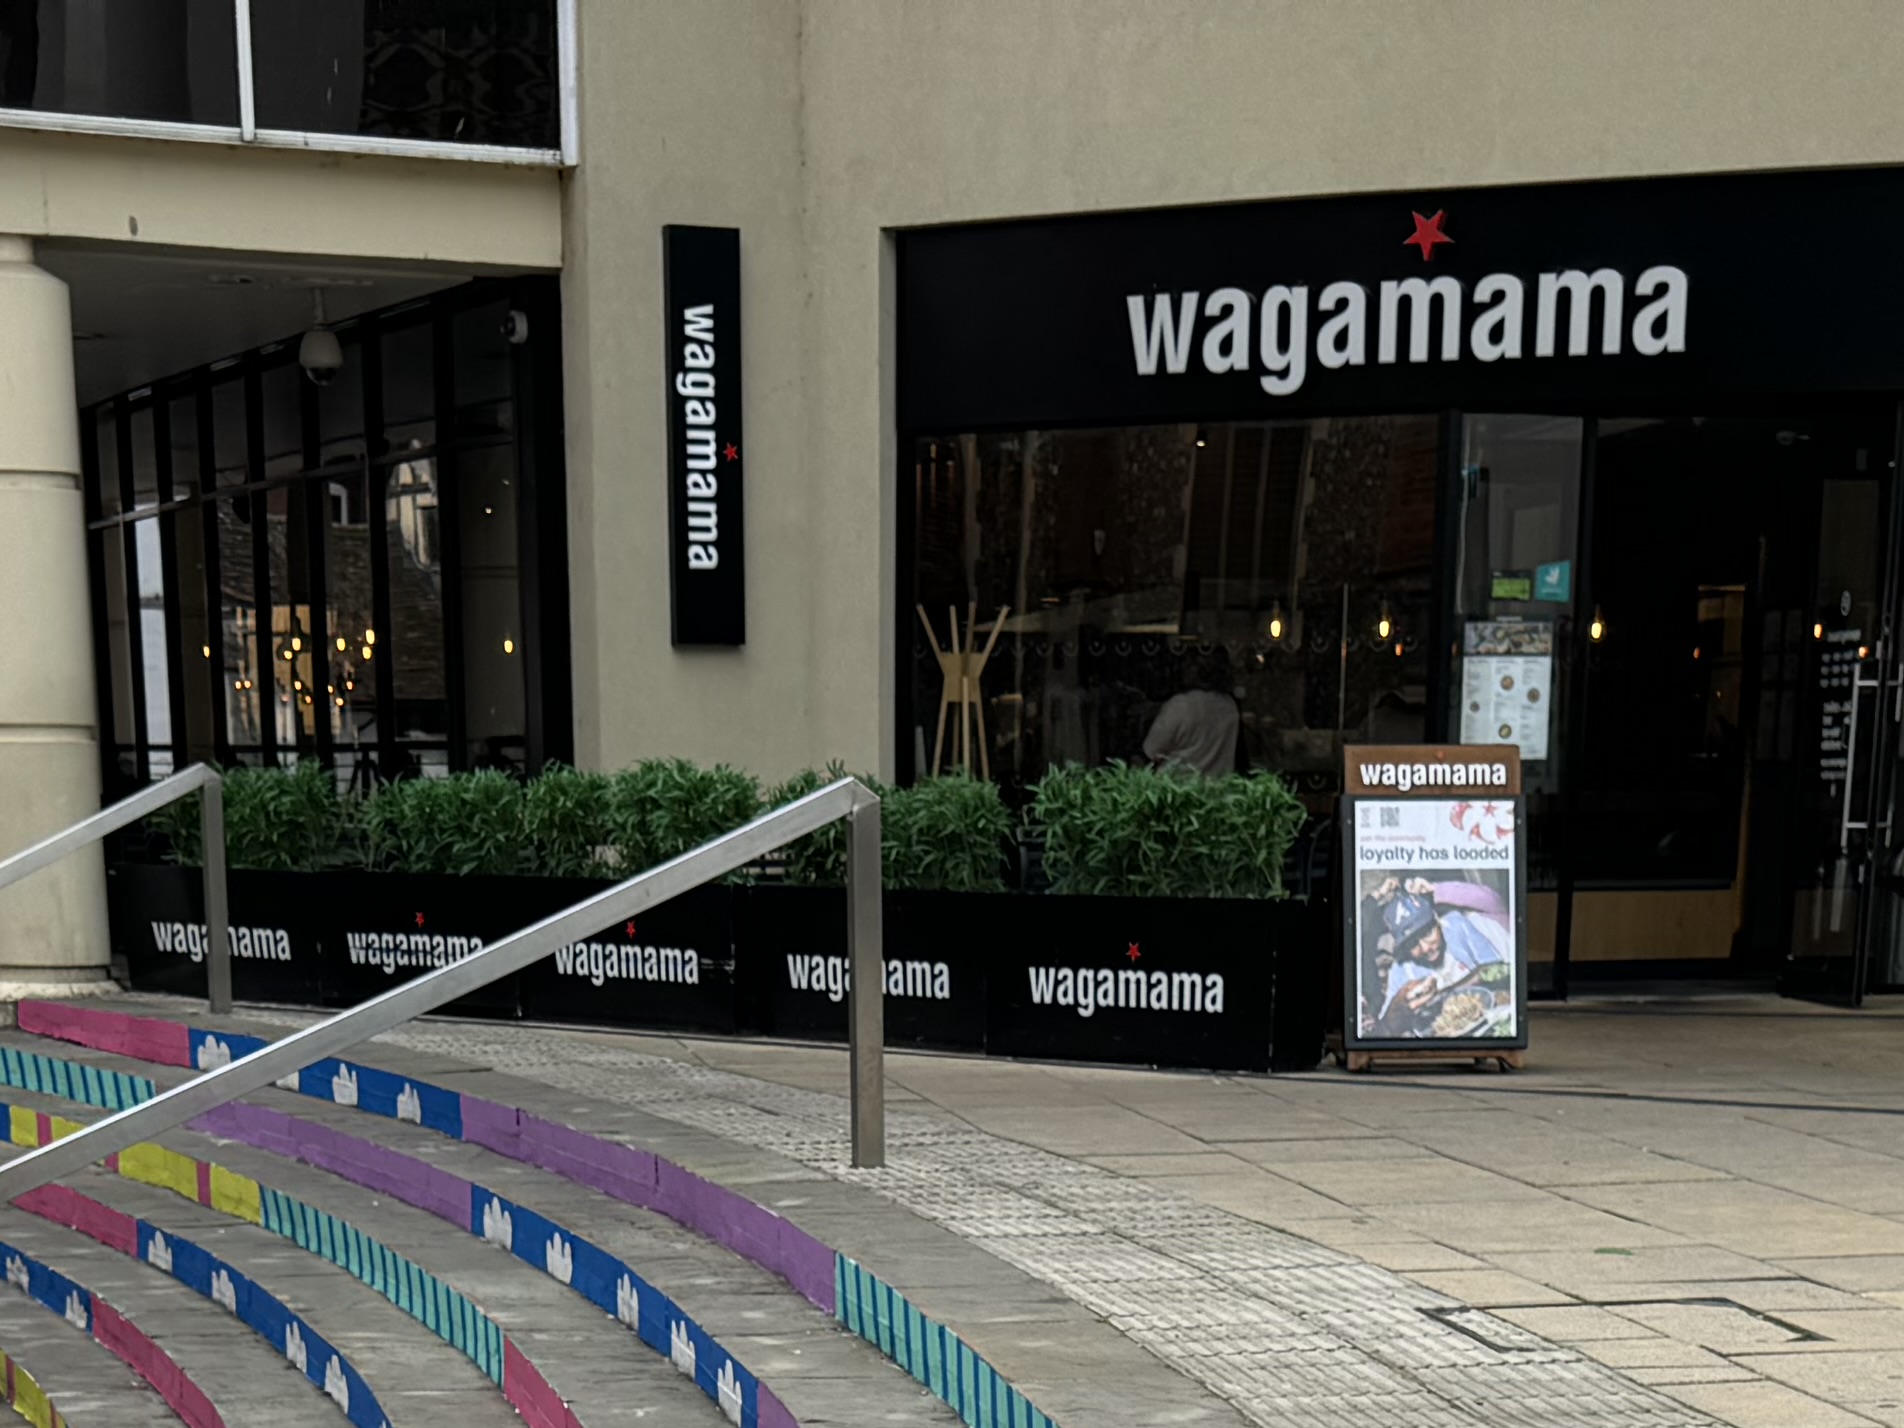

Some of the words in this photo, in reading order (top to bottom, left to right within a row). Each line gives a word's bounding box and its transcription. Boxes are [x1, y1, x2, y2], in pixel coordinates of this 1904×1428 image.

[1126, 264, 1690, 396] wagamama
[675, 303, 719, 570] wagamama
[1359, 762, 1507, 792] wagamama
[1360, 846, 1415, 864] loyalty
[1419, 845, 1449, 861] has
[1454, 845, 1509, 861] loaded
[555, 942, 699, 987] wagamama
[1028, 966, 1224, 1018] wagamama
